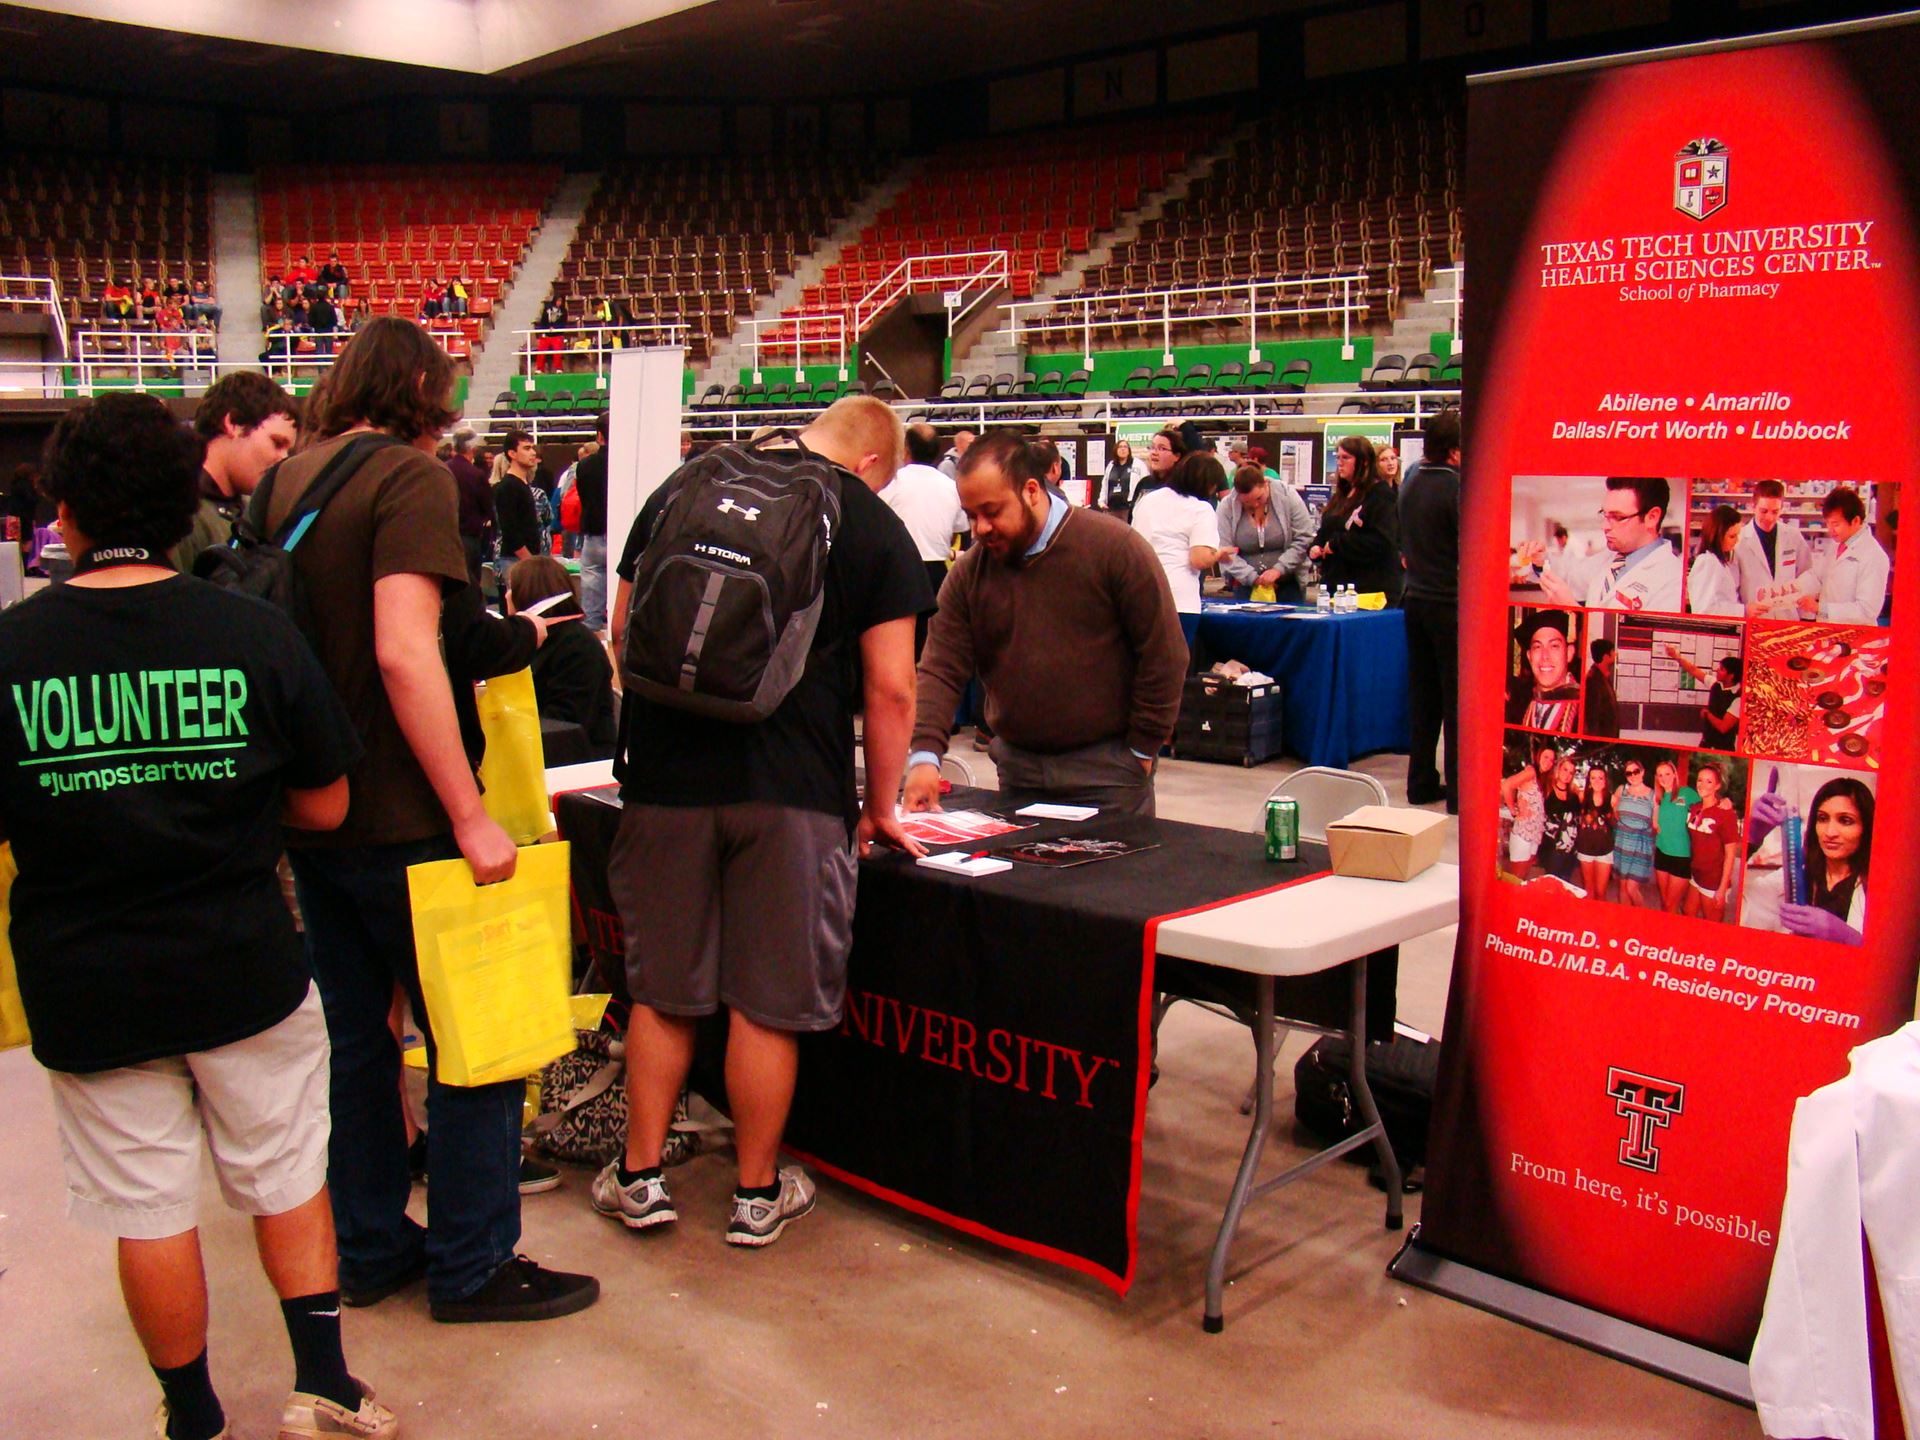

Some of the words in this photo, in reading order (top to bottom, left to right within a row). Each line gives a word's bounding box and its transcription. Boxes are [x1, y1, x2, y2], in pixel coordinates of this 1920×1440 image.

[1104, 64, 1124, 100] N
[1541, 239, 1614, 266] TEXAS
[1621, 233, 1694, 259] TECH
[1702, 220, 1874, 255] UNIVERSITY
[1540, 263, 1626, 287] HEALTH
[1634, 255, 1755, 281] SCIENCES
[1619, 284, 1673, 302] School
[1677, 282, 1696, 302] of
[1698, 282, 1780, 299] Pharmacy
[1597, 393, 1679, 411] Abilene
[1700, 391, 1792, 411] Amarillo
[1552, 420, 1660, 439] Dallas/Fort
[1665, 420, 1729, 439] Worth
[1751, 420, 1852, 440] Lubbock
[93, 547, 150, 563] Canon
[707, 545, 752, 566] STORM
[11, 668, 249, 752] VOLUNTEER
[39, 757, 237, 796] #jumpstartwct
[1516, 917, 1601, 949] Pharm.D.
[1624, 938, 1717, 972] Graduate
[1720, 957, 1816, 992] Program
[1484, 933, 1630, 981] Pharm.D./M.B.A.
[1652, 970, 1759, 1011] Residency
[1763, 993, 1861, 1029] Program
[1510, 1151, 1567, 1186] From
[1573, 1167, 1628, 1208] here,
[1674, 1203, 1772, 1247] possible
